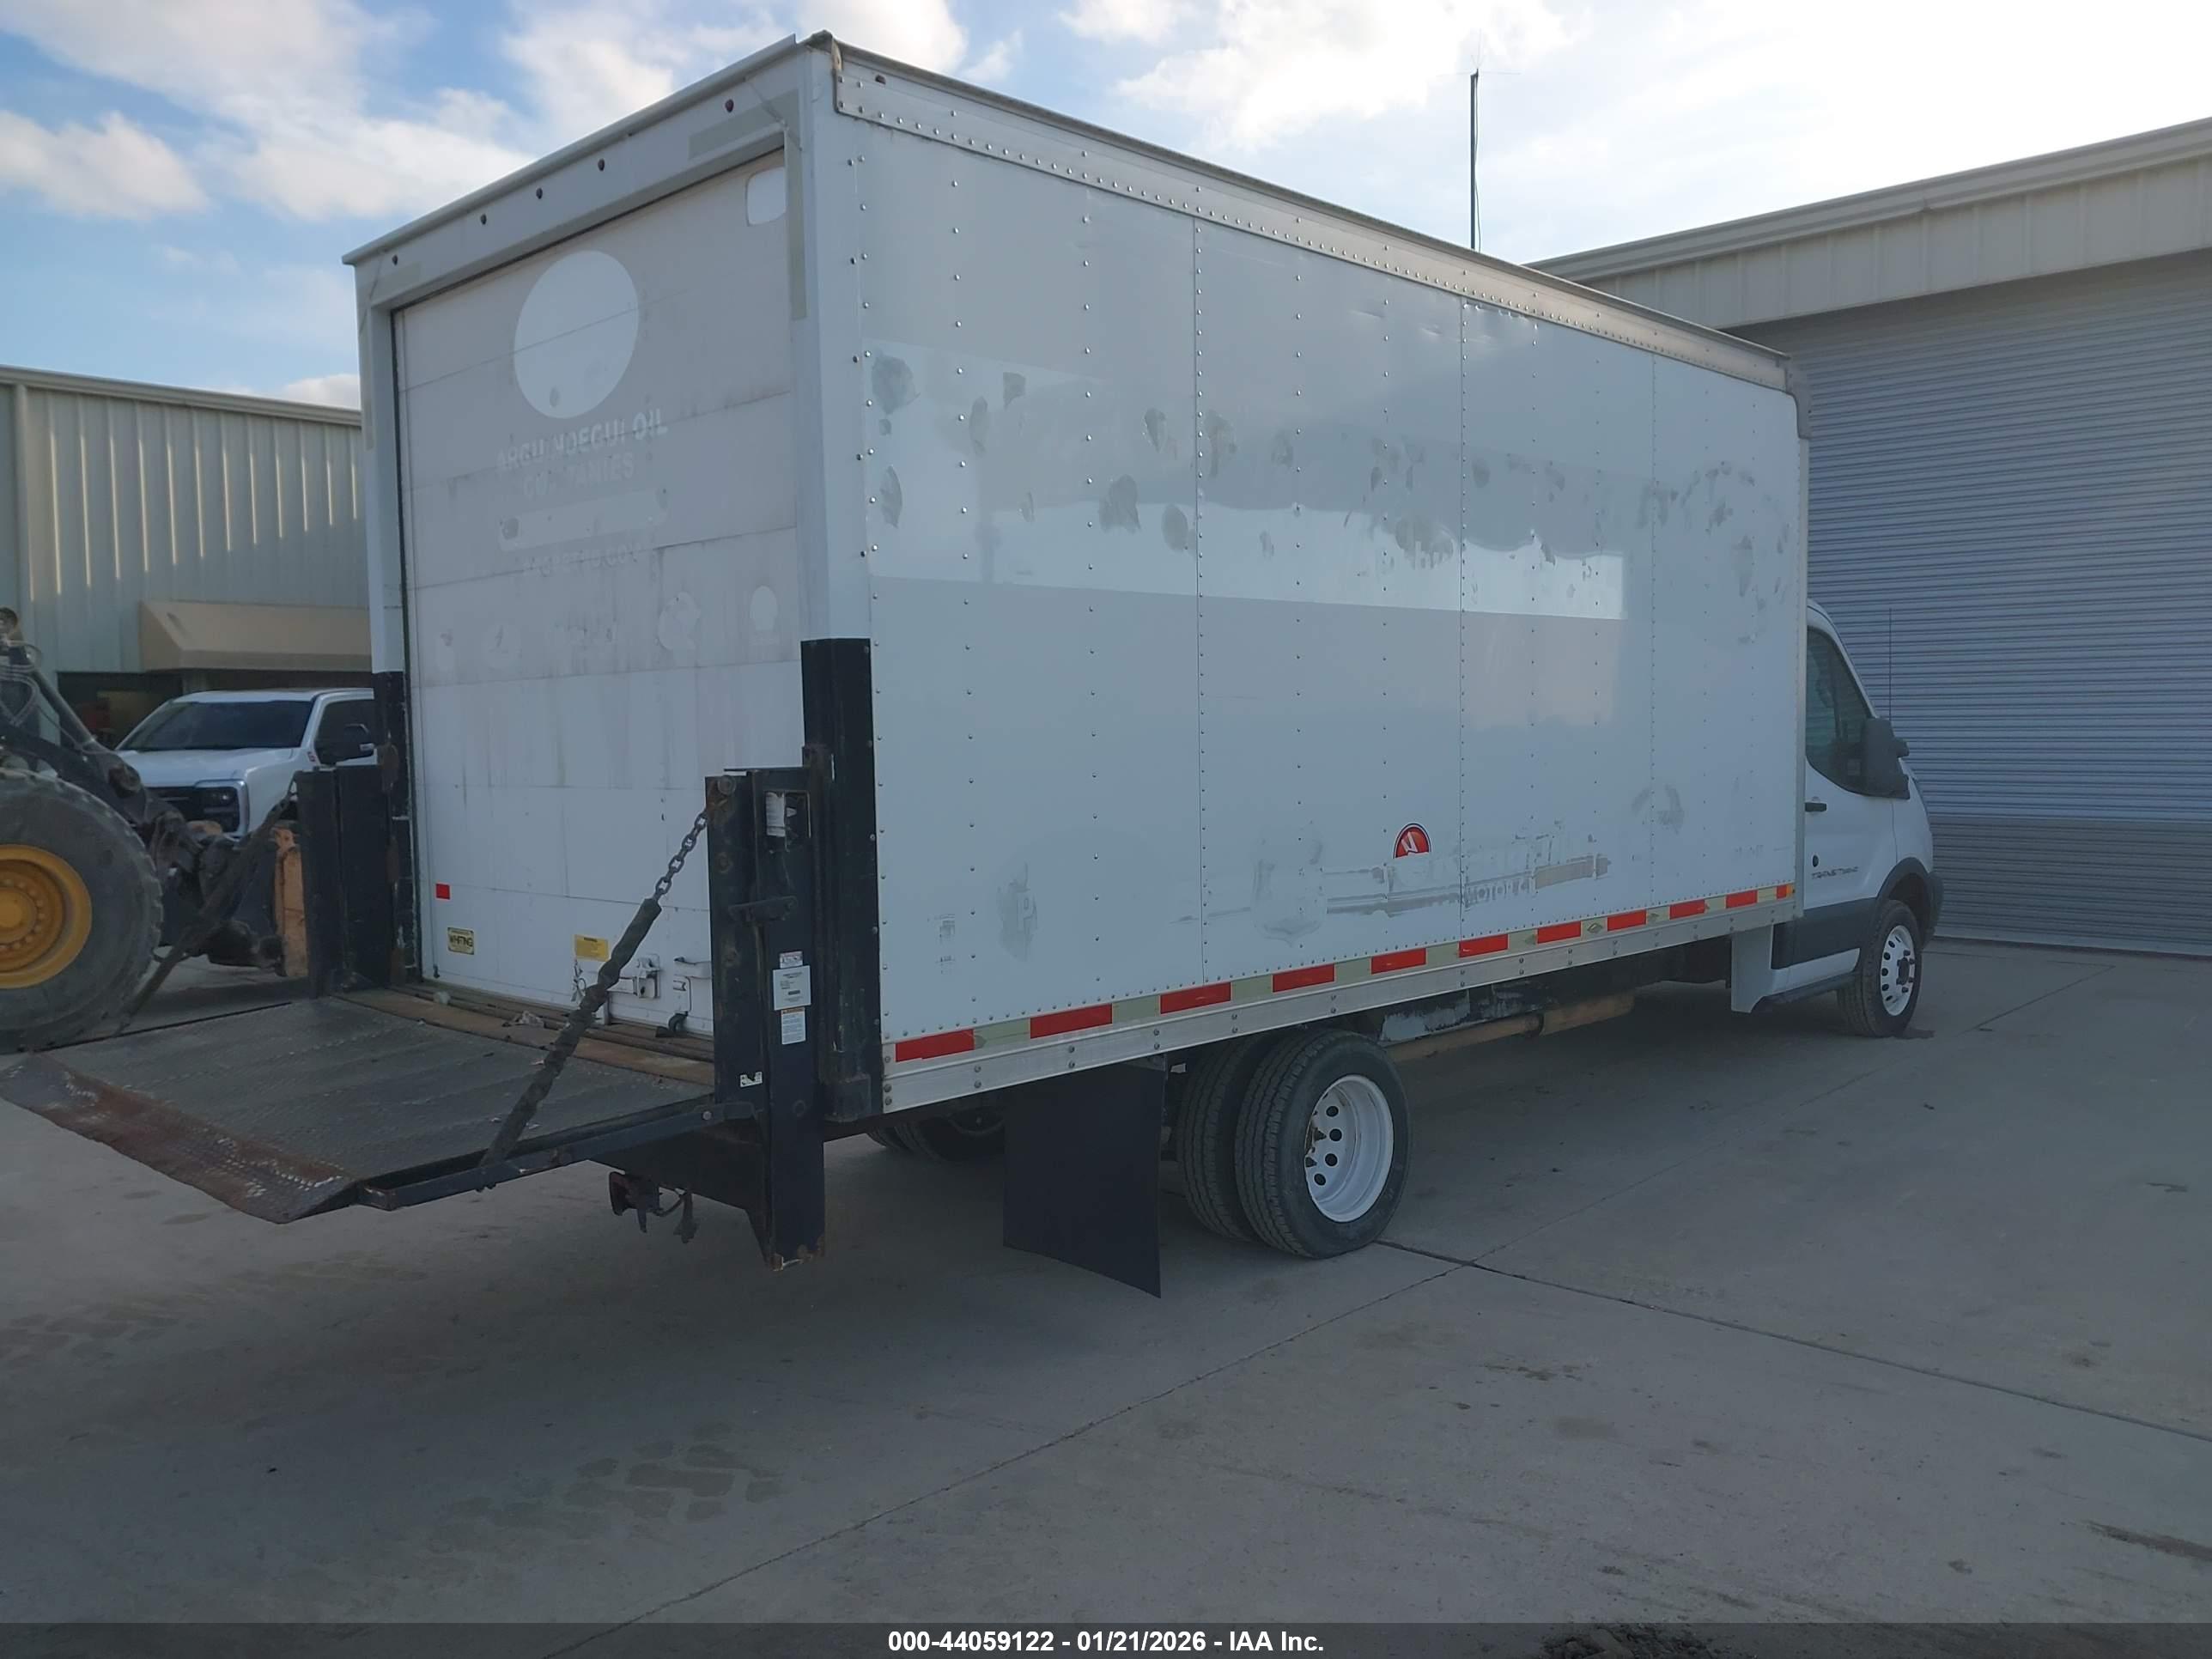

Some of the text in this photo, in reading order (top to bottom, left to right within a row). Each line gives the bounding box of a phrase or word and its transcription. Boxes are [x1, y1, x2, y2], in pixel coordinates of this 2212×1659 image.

[495, 408, 668, 471] ARGUNDEGUI OIL
[522, 451, 635, 499] COANIES
